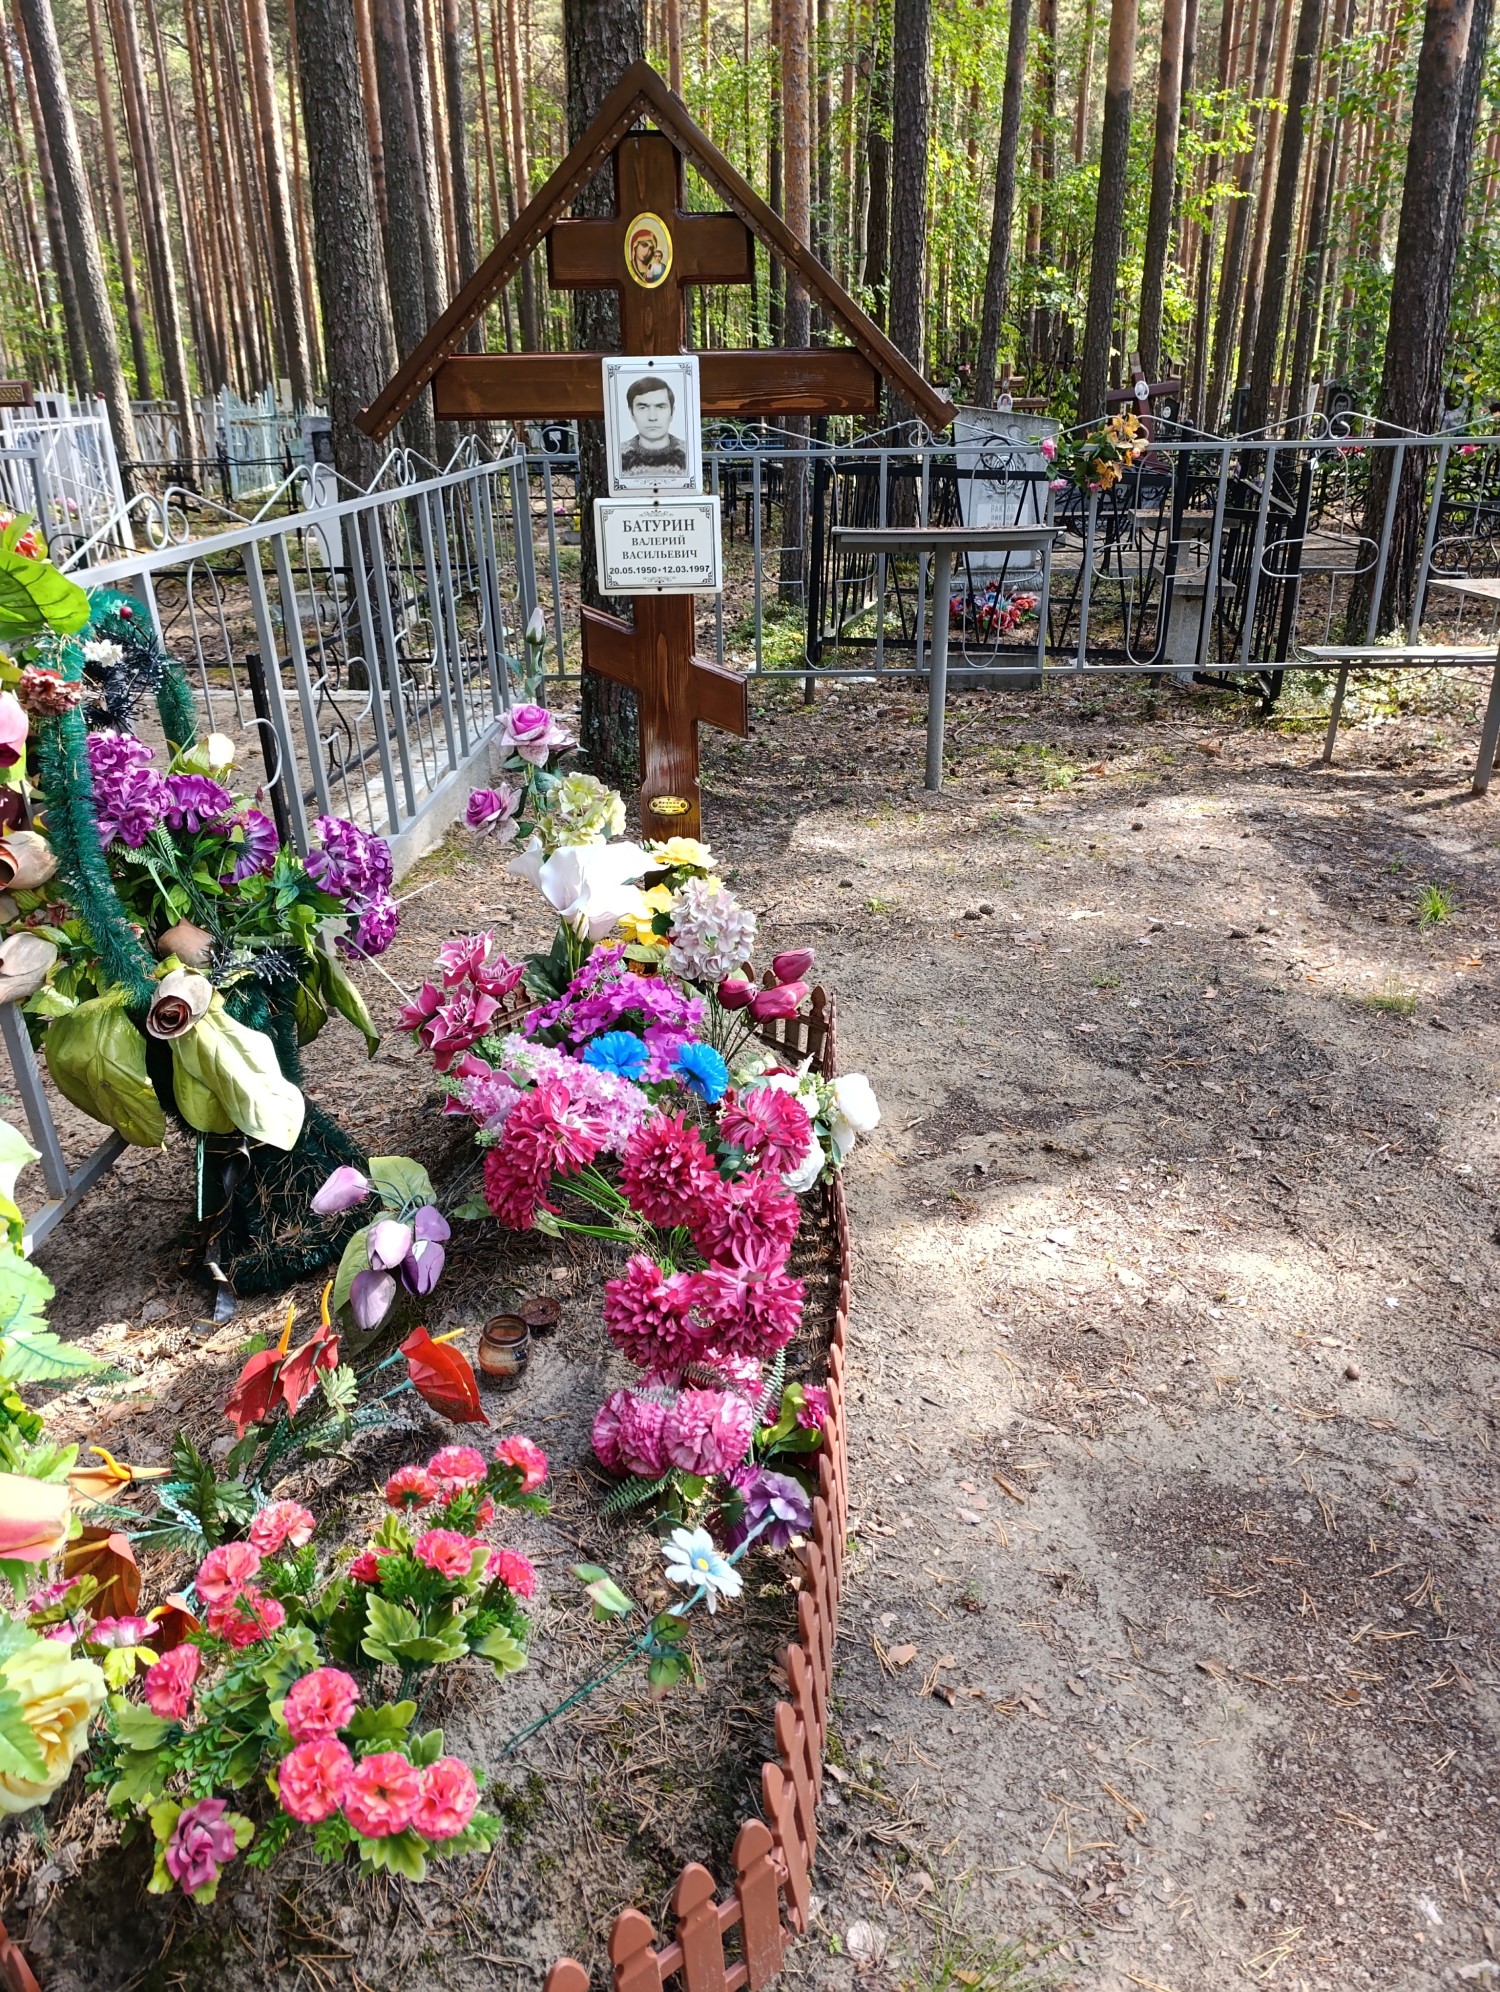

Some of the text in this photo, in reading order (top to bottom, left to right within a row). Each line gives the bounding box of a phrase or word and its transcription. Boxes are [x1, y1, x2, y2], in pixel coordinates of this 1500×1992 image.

[990, 504, 1016, 512] РАКЛЬ
[623, 518, 695, 532] БАТУРИН
[631, 534, 686, 546] ВАЛЕРИЙ
[622, 549, 697, 559] ВАСИЛЬЕВИЧ
